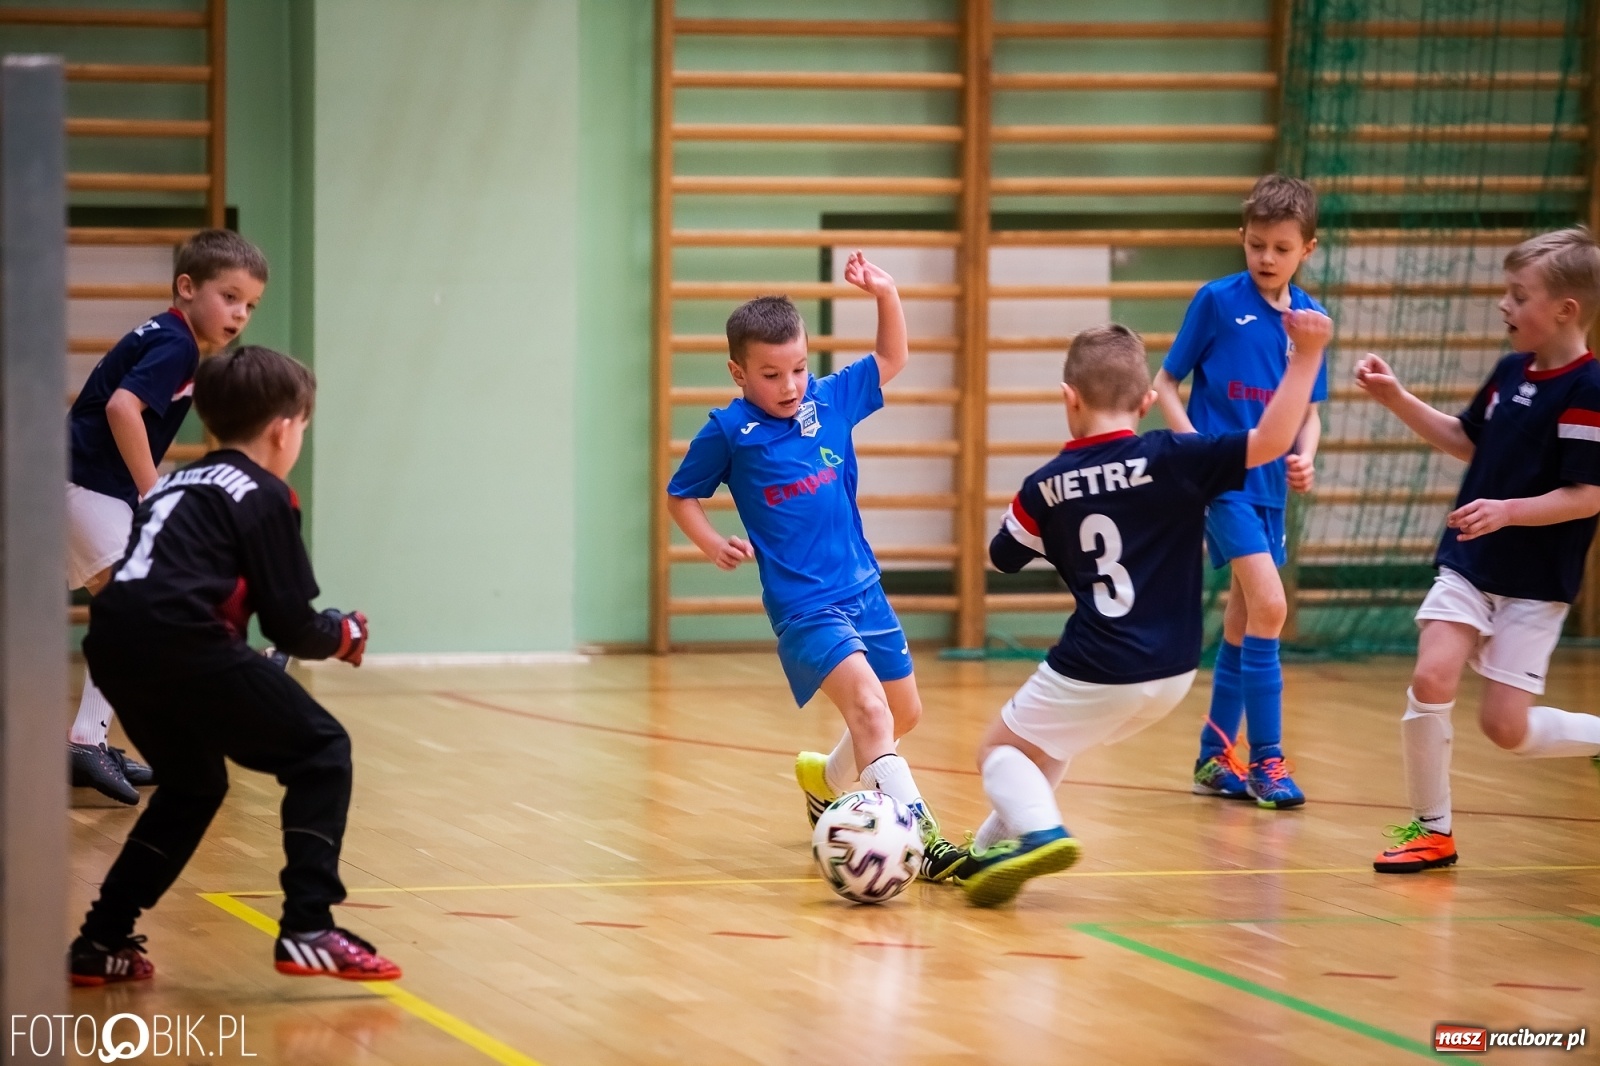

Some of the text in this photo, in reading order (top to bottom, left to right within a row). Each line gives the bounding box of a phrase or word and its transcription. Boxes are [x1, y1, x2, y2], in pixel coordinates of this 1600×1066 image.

[1037, 457, 1153, 507] KIETRZ
[114, 490, 185, 582] 1
[1079, 513, 1136, 618] 3
